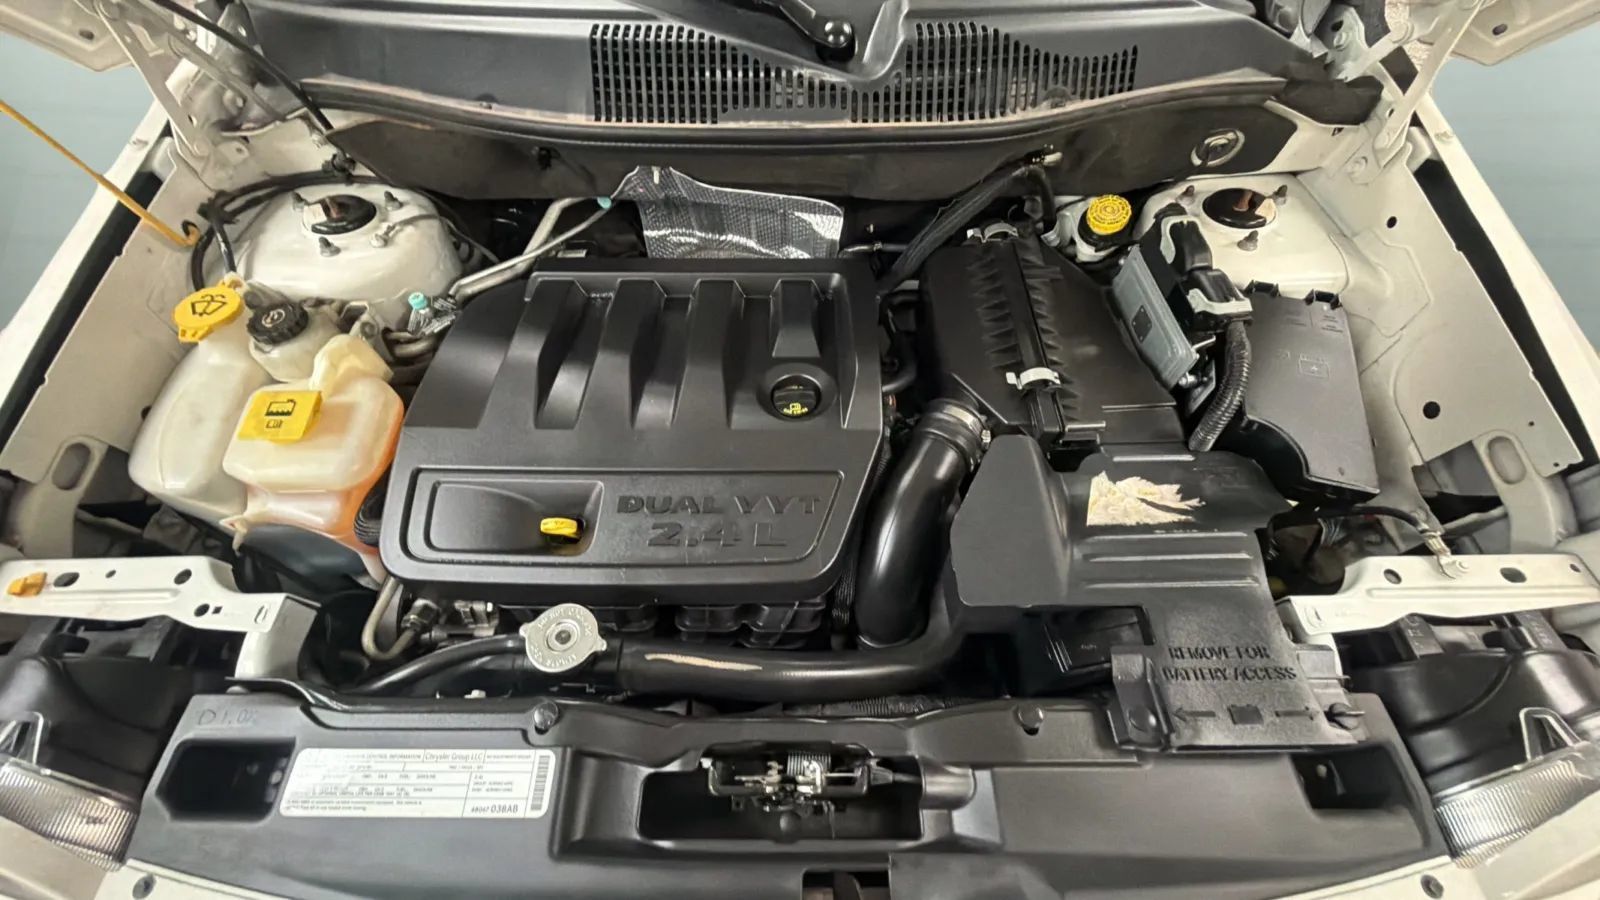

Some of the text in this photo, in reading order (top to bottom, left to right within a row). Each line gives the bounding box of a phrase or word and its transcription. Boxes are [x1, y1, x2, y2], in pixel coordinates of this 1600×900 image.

[617, 495, 724, 514] DUAL
[647, 522, 787, 547] 2.4 L
[1168, 646, 1270, 660] REMOVE FOR
[1162, 667, 1297, 681] BATTERY ACCESS
[425, 751, 449, 762] Chrysler
[451, 751, 470, 762] Group
[471, 751, 483, 761] LLC
